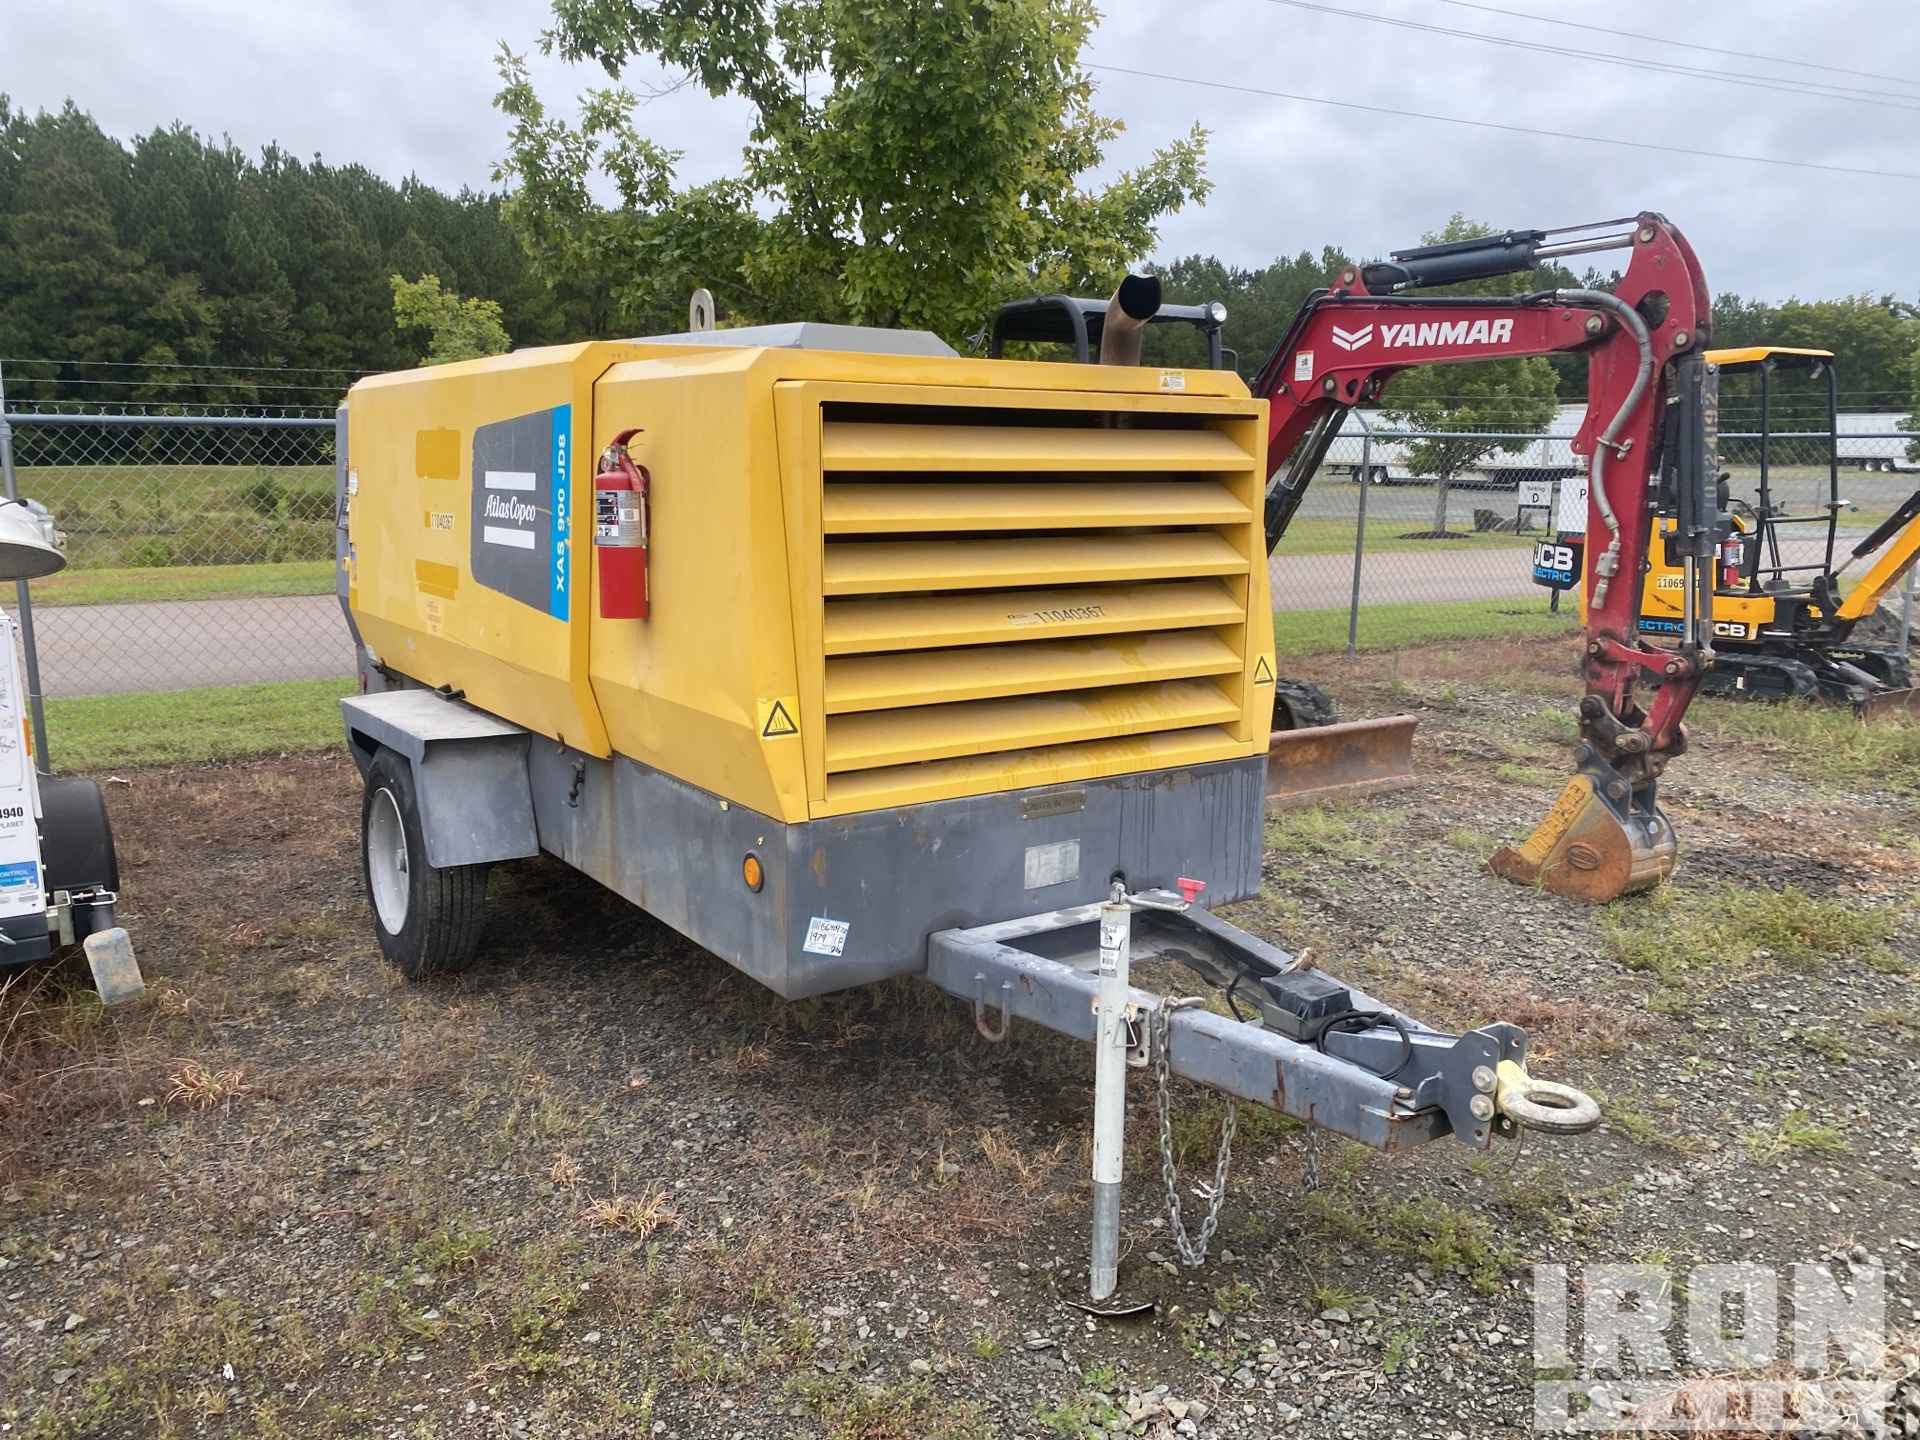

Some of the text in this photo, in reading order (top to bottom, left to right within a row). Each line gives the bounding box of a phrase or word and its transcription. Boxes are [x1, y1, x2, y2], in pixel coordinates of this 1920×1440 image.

[1380, 319, 1513, 348] YANMAR
[1532, 492, 1539, 503] D
[556, 433, 566, 592] XAS 900 JD8
[1534, 543, 1574, 570] JCB
[1034, 605, 1106, 623] 11040367
[1714, 622, 1746, 637] CB
